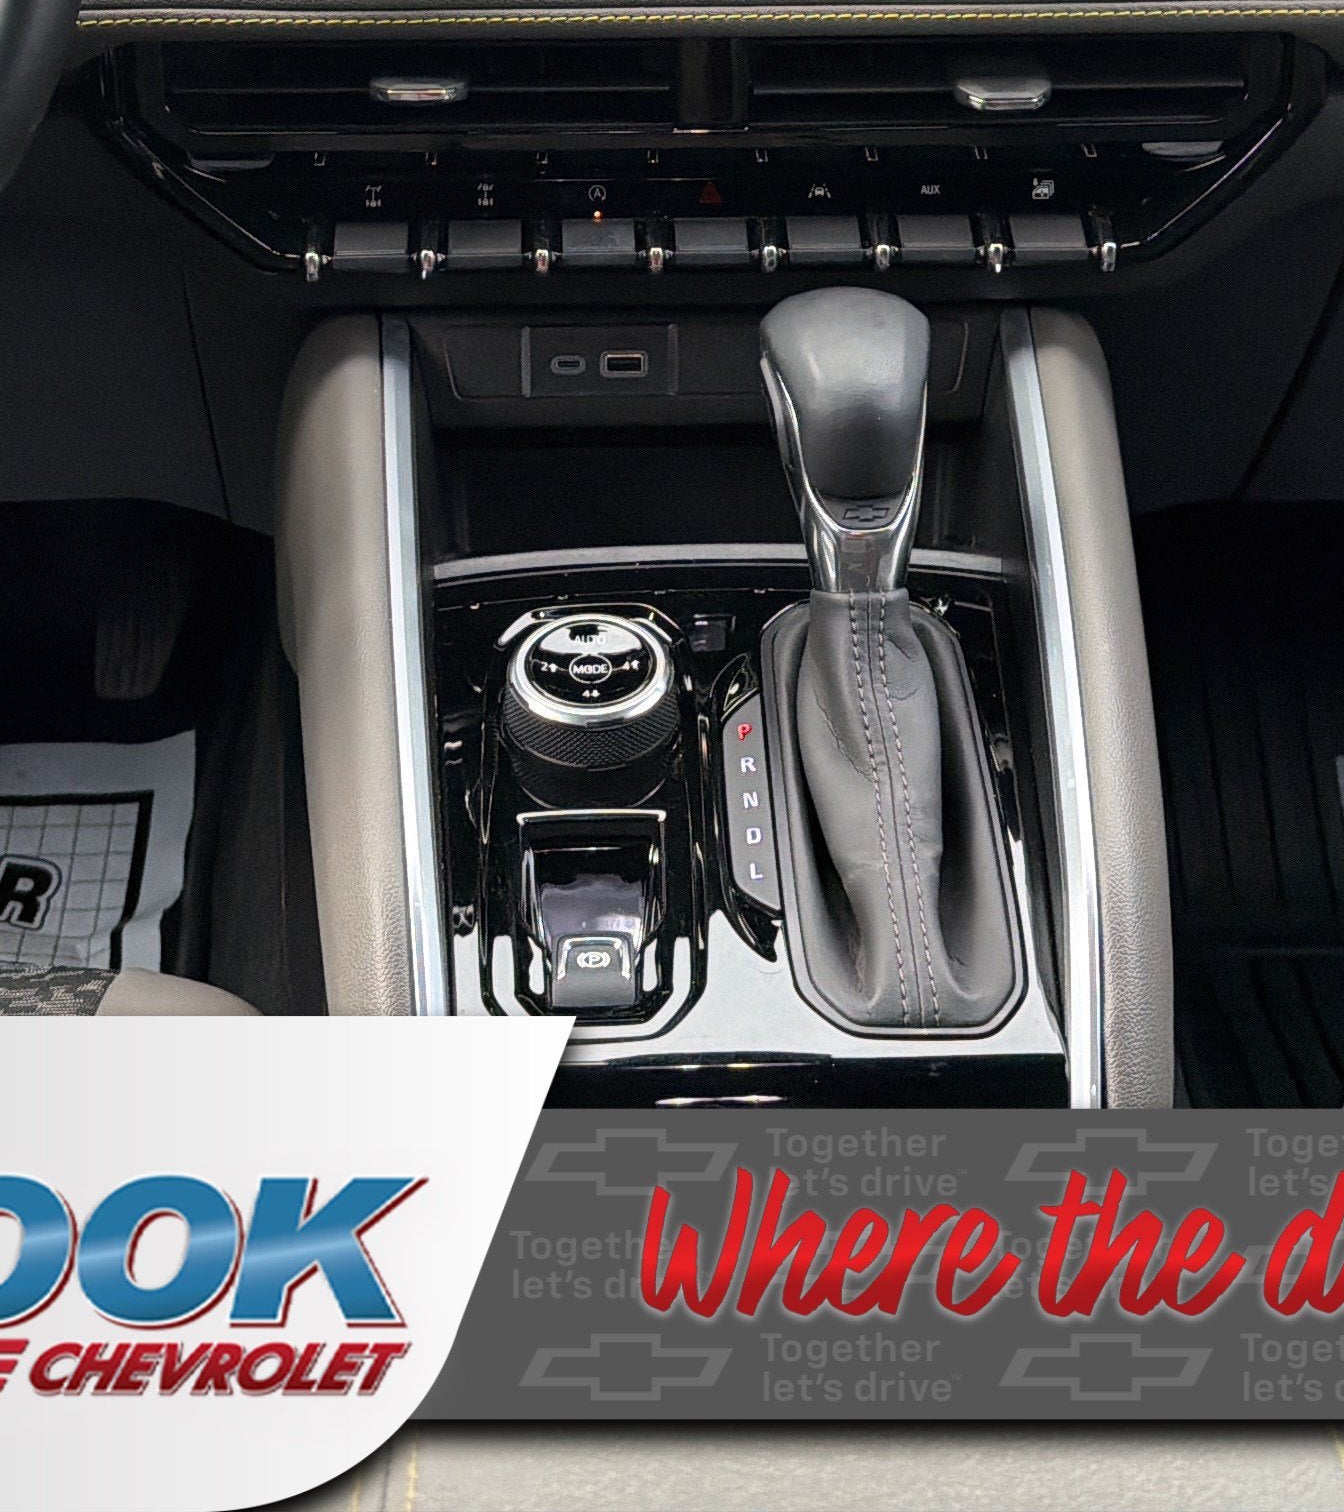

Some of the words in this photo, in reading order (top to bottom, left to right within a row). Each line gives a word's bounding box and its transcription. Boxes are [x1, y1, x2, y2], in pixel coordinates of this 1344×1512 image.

[920, 184, 941, 195] AUX
[572, 664, 609, 674] MODE
[737, 722, 753, 742] P
[740, 756, 757, 773] R
[742, 790, 759, 809] N
[746, 827, 762, 845] D
[749, 862, 764, 880] L
